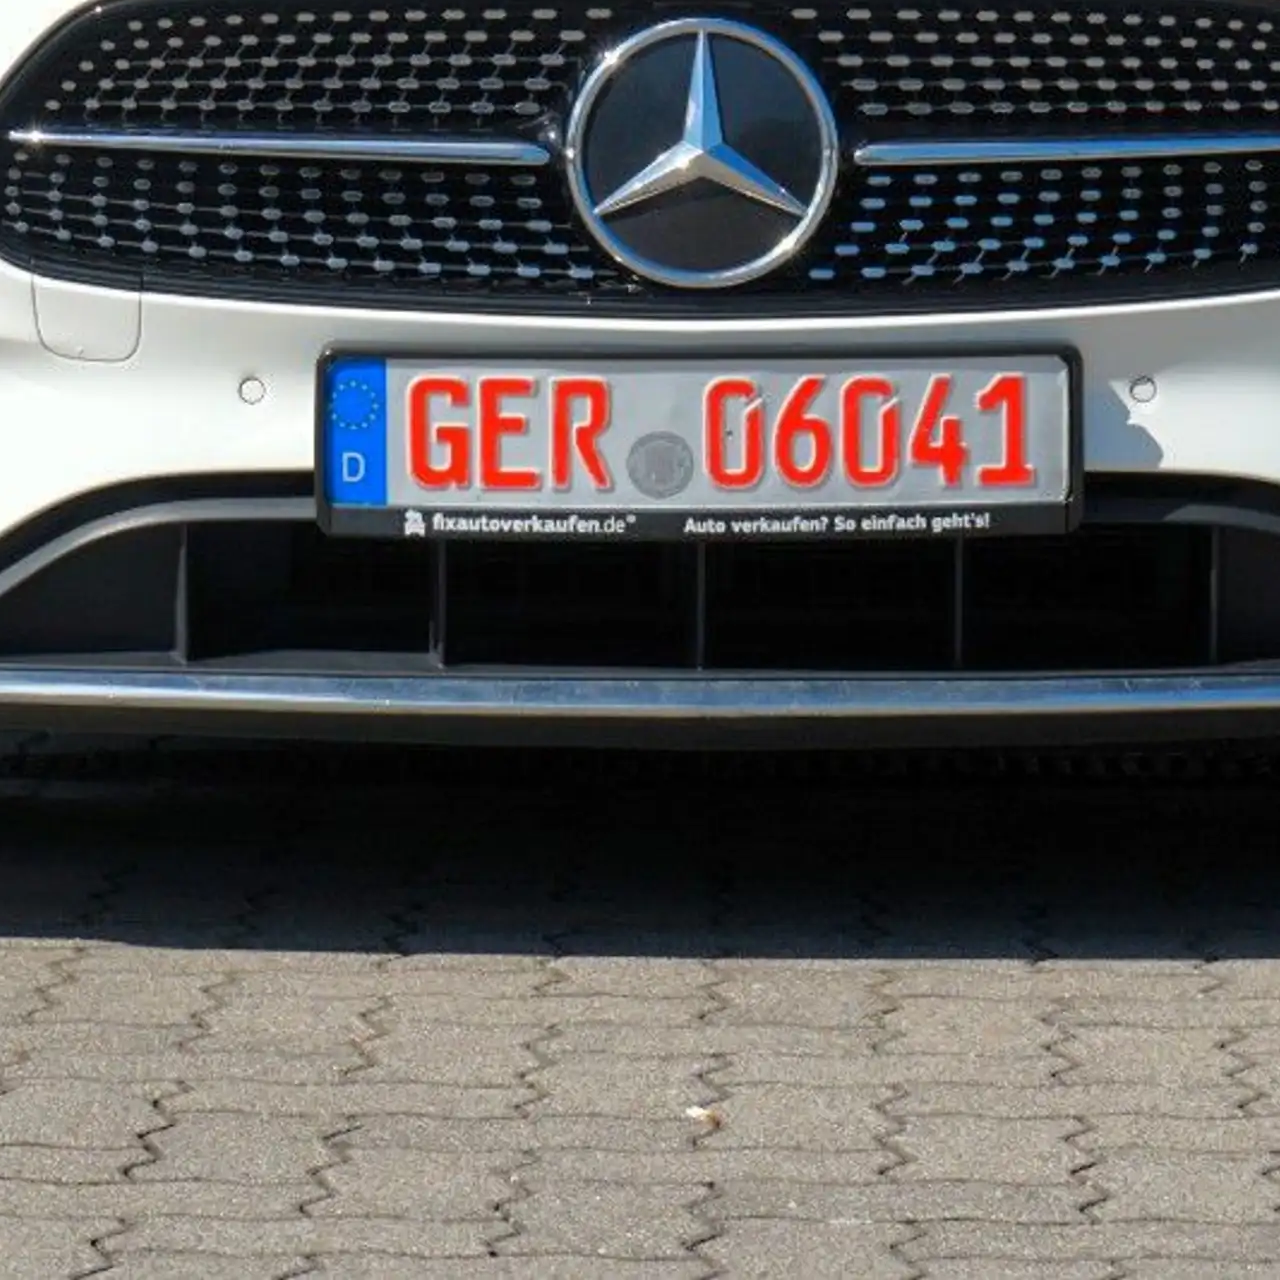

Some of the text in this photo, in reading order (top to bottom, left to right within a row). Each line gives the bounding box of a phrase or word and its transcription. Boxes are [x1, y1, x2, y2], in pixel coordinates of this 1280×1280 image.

[406, 373, 1037, 490] GER 06041
[341, 451, 366, 482] D
[683, 517, 726, 534] Auto
[731, 516, 828, 533] verkaufen?
[834, 515, 856, 531] So
[861, 512, 927, 531] einfach
